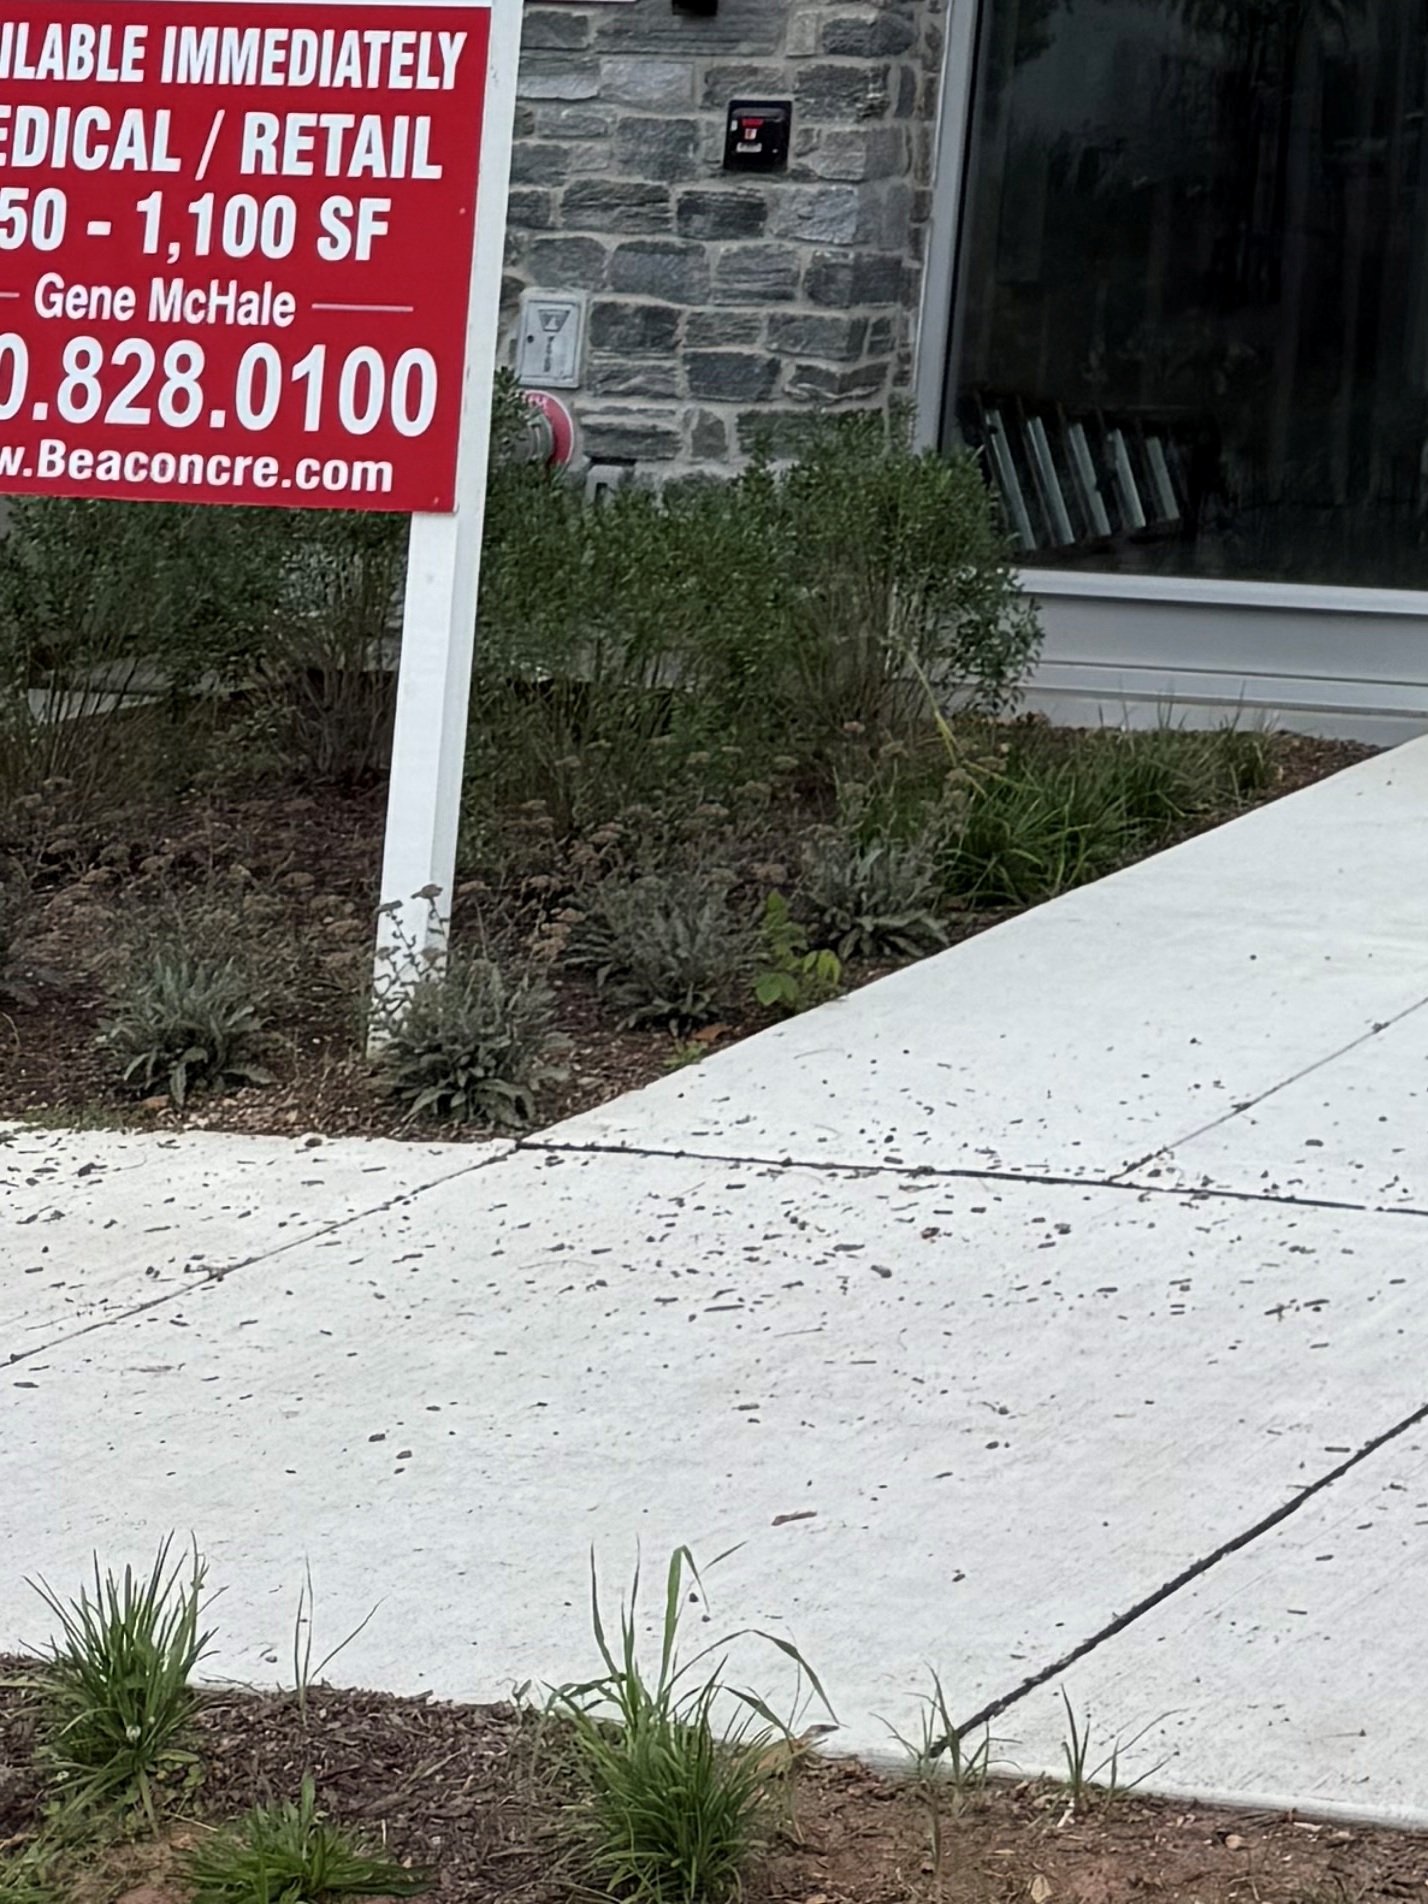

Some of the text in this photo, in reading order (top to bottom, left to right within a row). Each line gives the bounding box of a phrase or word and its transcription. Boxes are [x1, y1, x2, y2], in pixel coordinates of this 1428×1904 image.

[0, 22, 468, 90] ILABLE IMMEDIATELY
[194, 109, 226, 181] /
[240, 111, 443, 180] RETAIL
[86, 221, 112, 236] -
[136, 191, 297, 264] 1,100
[317, 195, 392, 262] SF
[34, 272, 297, 328] Gene McHale
[0, 332, 438, 438] 0.828.0100
